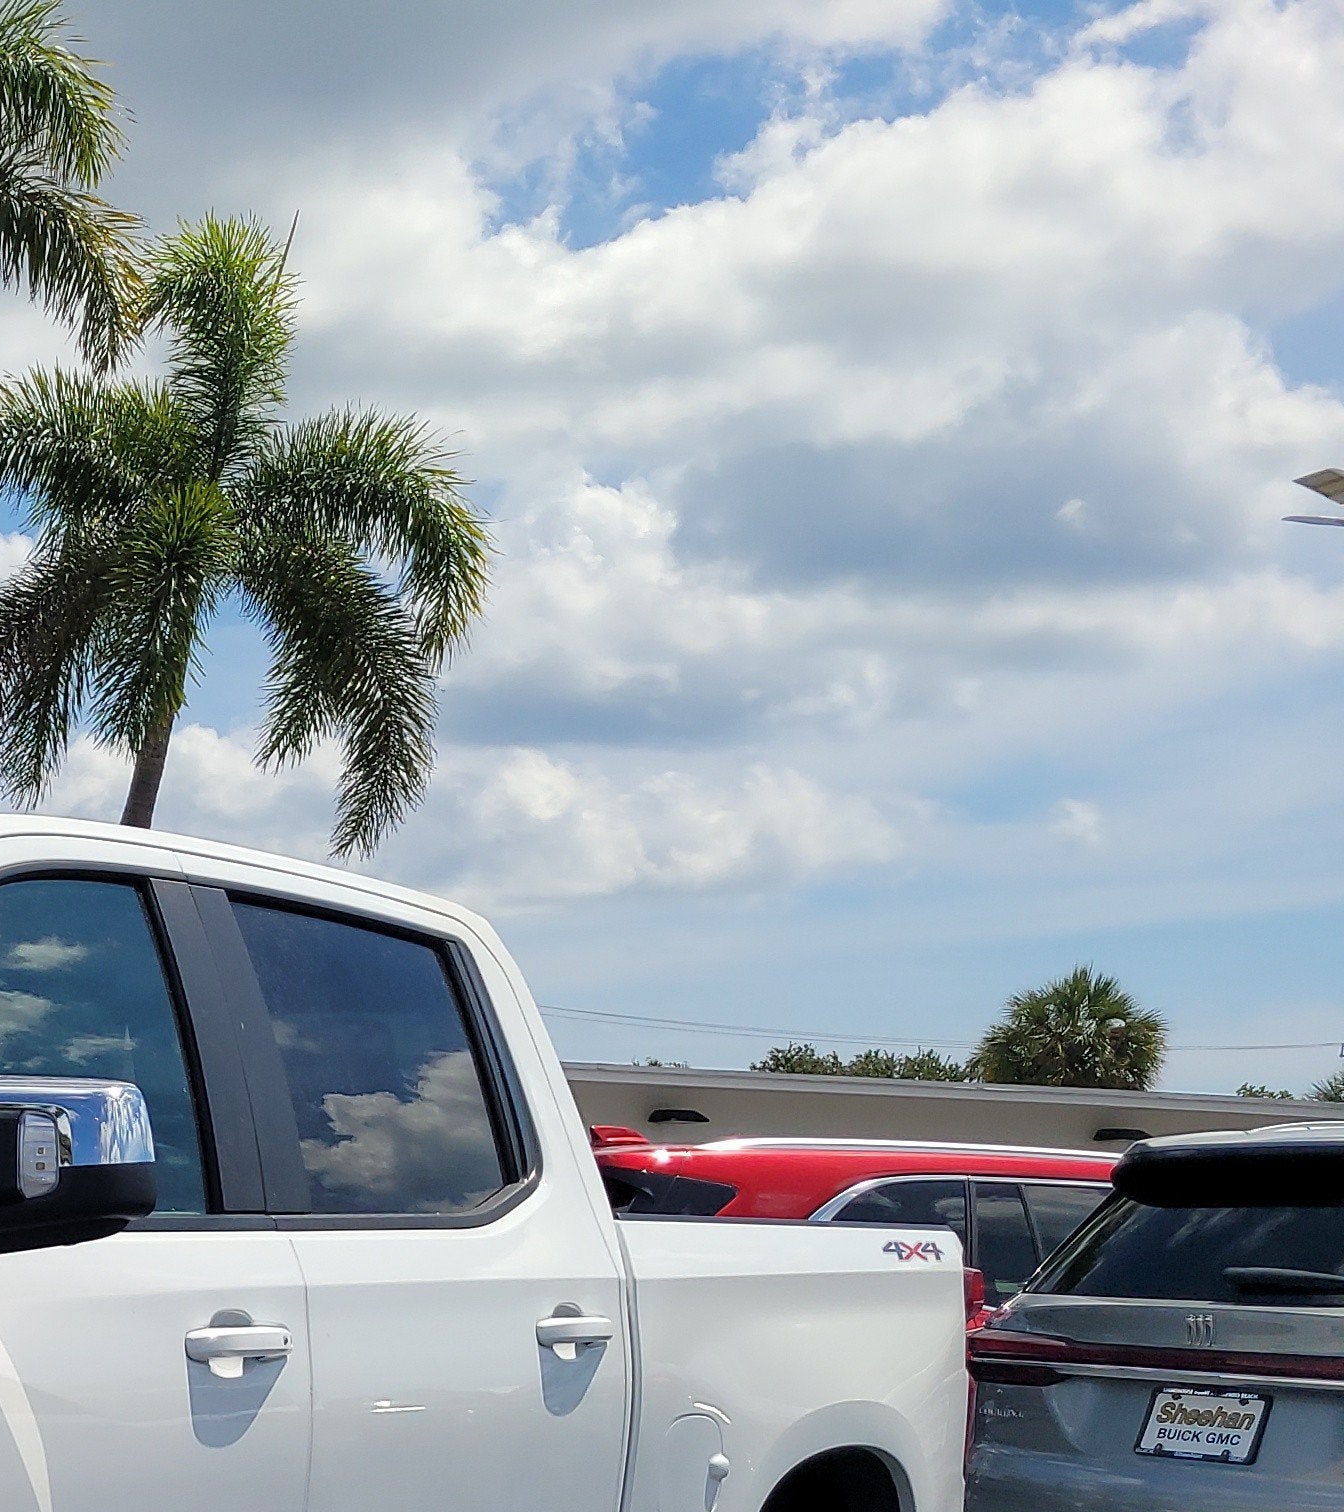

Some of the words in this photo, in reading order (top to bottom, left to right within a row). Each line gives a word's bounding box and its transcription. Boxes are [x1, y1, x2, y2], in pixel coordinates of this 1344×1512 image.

[1156, 1402, 1255, 1430] Sheehan
[1156, 1428, 1203, 1443] BUICK
[1206, 1432, 1241, 1446] GMC
